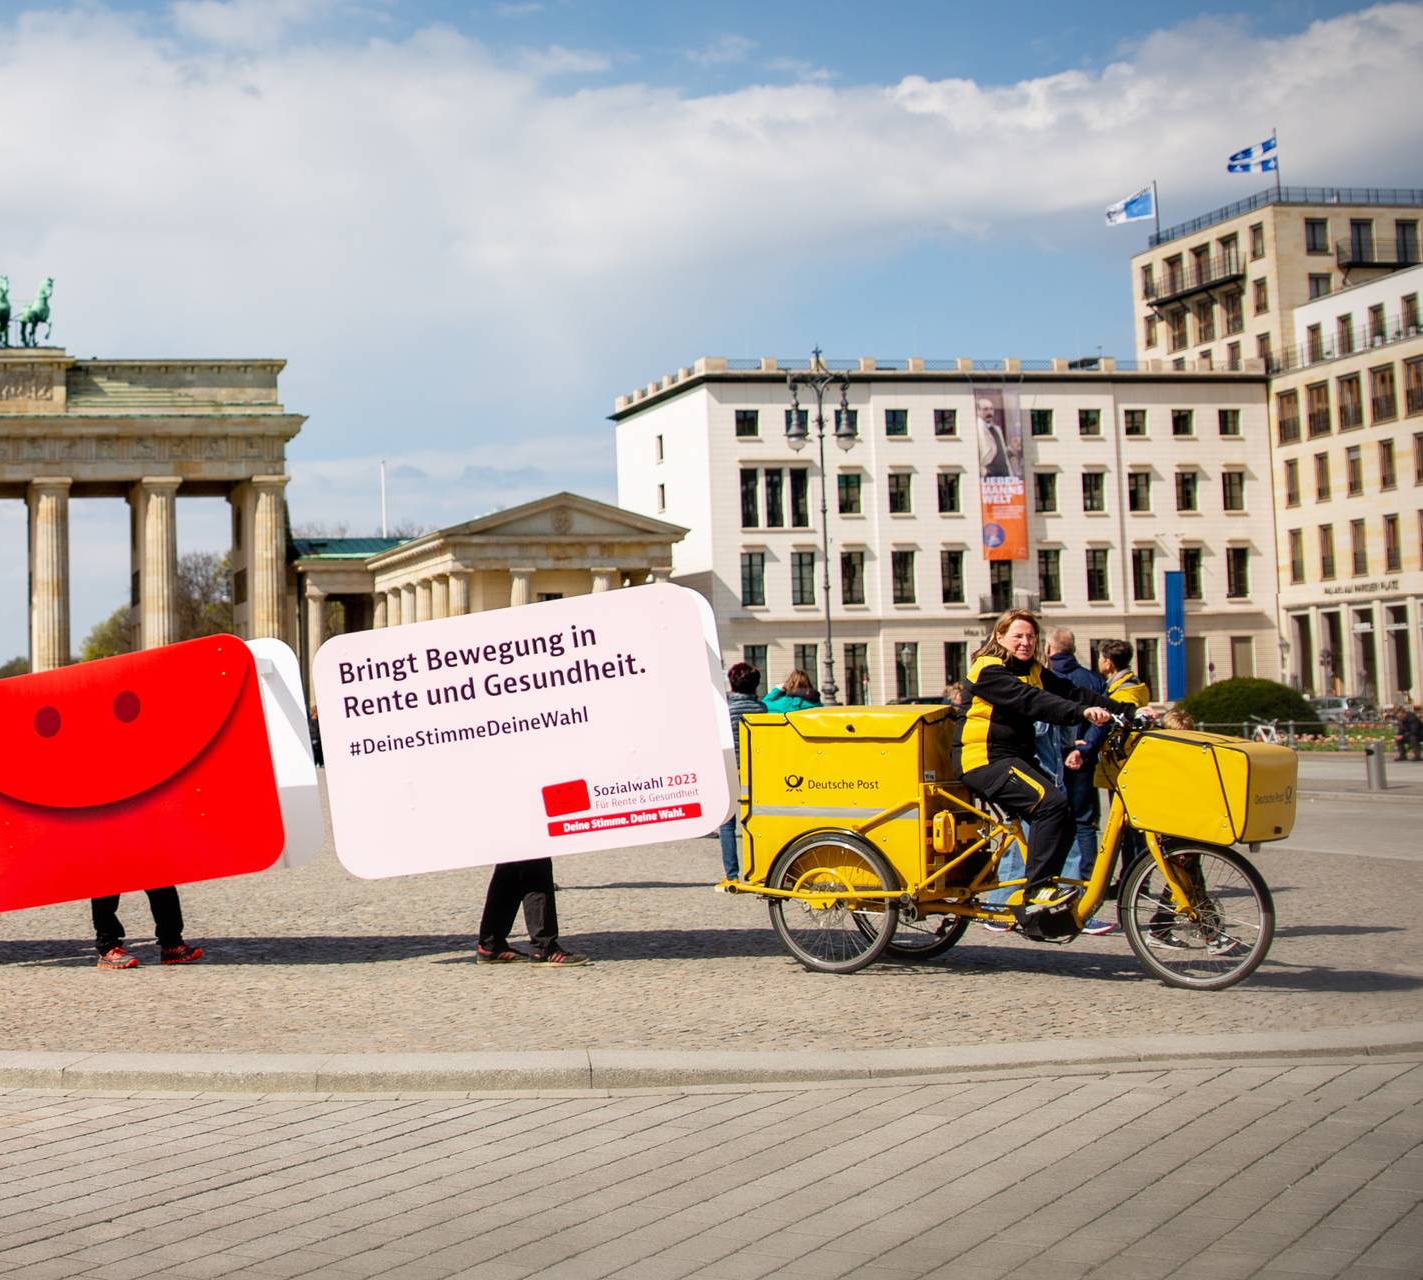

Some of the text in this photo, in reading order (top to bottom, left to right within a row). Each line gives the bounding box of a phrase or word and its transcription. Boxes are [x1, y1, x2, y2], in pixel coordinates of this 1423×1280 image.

[338, 624, 597, 685] Bringt Bewegung in
[343, 653, 647, 719] Rente und Gesundheit.
[349, 705, 589, 757] #DeineStimmeDeineWahl
[593, 773, 698, 797] Sozialwahl 2023
[807, 779, 879, 790] Deutsche Post
[595, 800, 609, 809] Für
[611, 797, 637, 808] Rente
[648, 788, 700, 802] Gesundheit
[563, 807, 686, 832] Deine Stimme. Deine Wahl.
